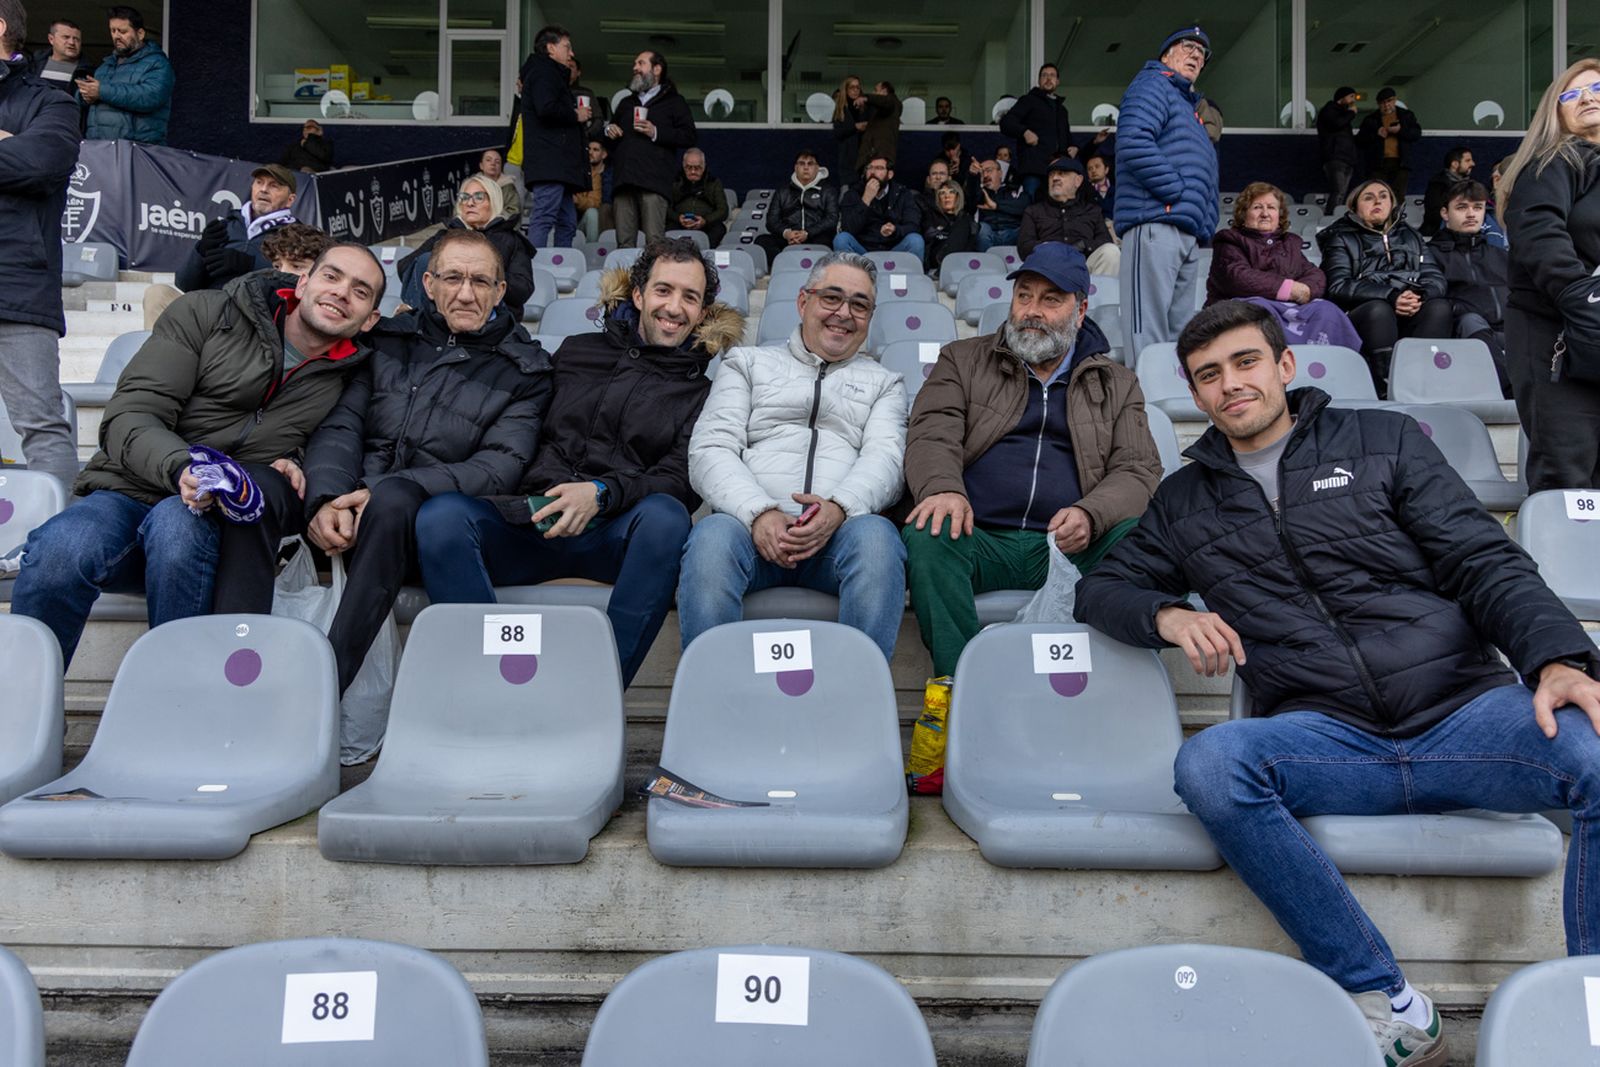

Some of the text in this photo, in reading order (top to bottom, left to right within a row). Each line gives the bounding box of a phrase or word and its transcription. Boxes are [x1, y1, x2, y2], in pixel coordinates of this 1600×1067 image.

[1312, 475, 1349, 492] PUMA
[1577, 498, 1595, 511] 98
[501, 625, 525, 642] 88
[771, 643, 795, 660] 90
[1049, 643, 1074, 661] 92
[1178, 971, 1195, 984] 092
[744, 975, 782, 1003] 90
[312, 992, 349, 1020] 88
